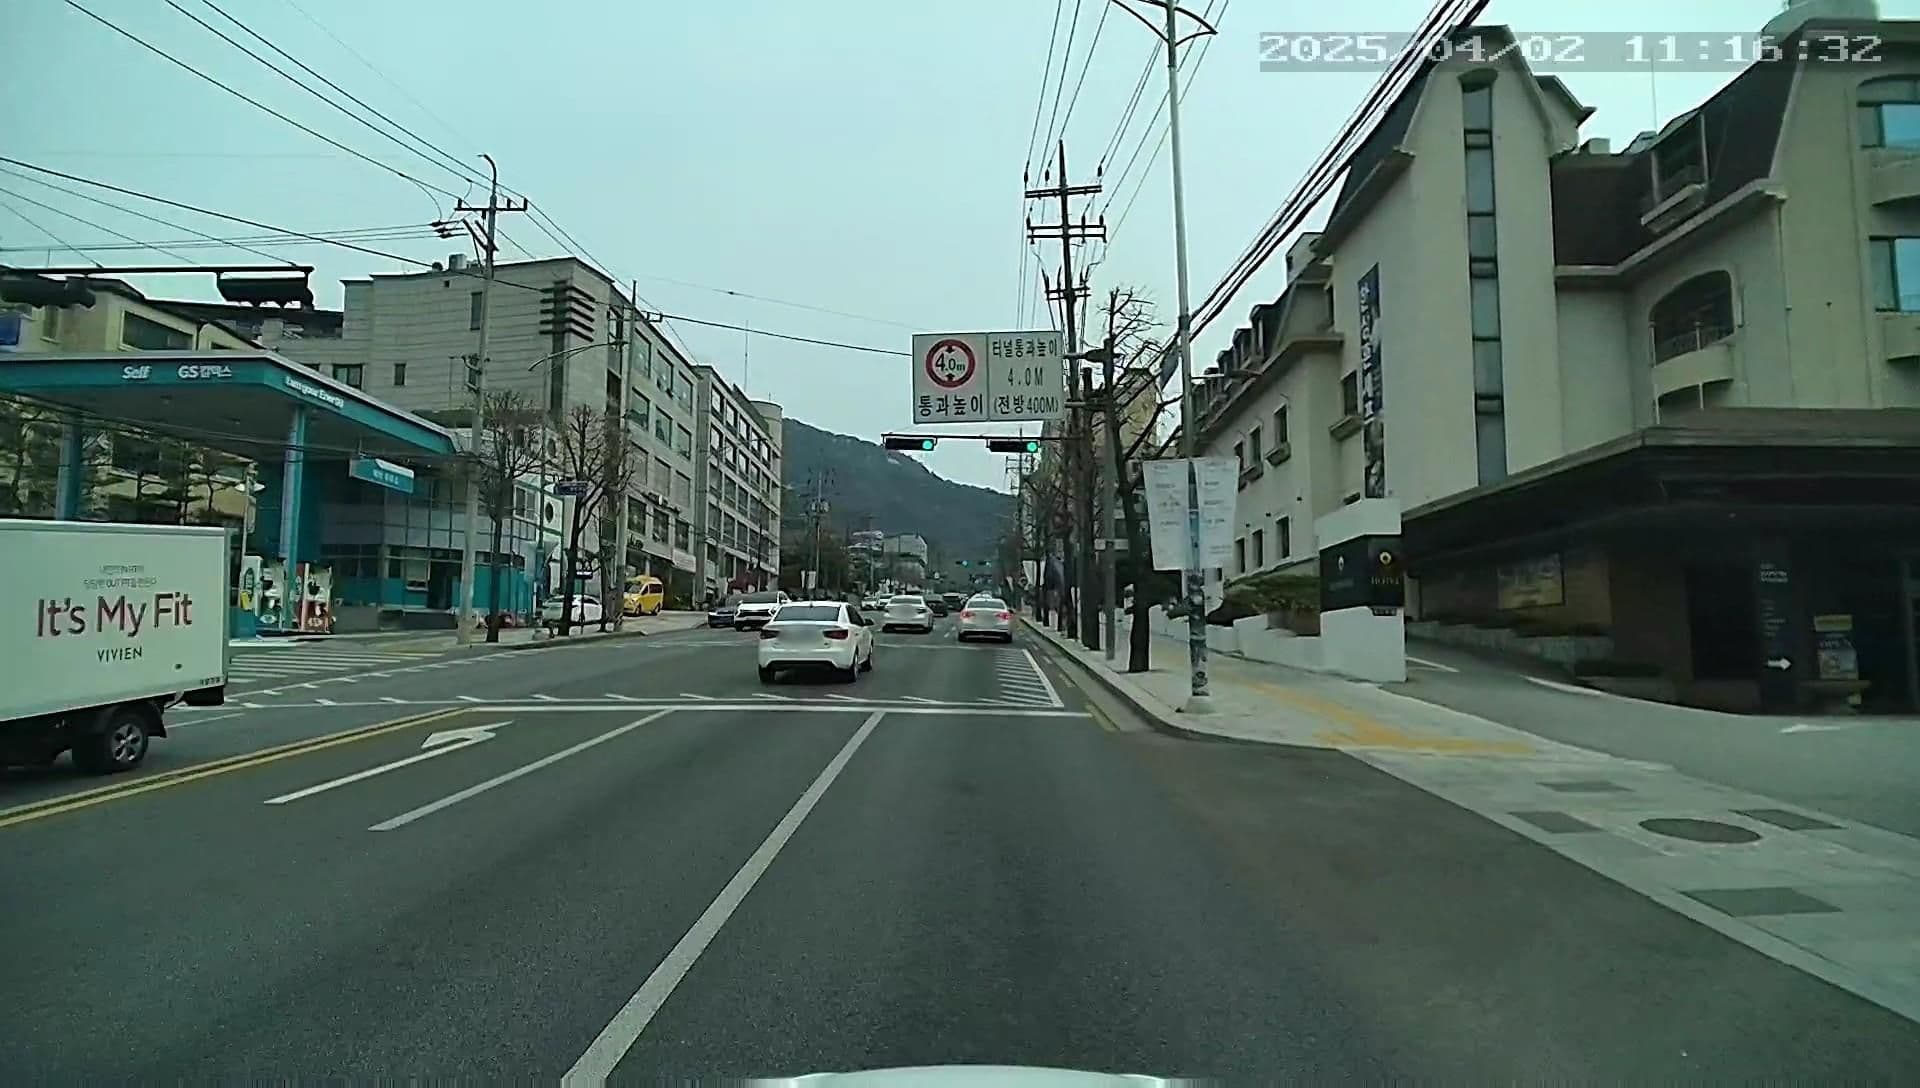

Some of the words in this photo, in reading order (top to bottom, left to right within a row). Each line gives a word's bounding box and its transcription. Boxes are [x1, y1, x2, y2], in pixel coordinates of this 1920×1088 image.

[122, 365, 151, 379] Self
[919, 394, 983, 416] 통과높이
[37, 597, 86, 637] It's
[97, 594, 147, 637] My
[153, 591, 193, 628] Fit
[97, 646, 143, 663] VIVIEN
